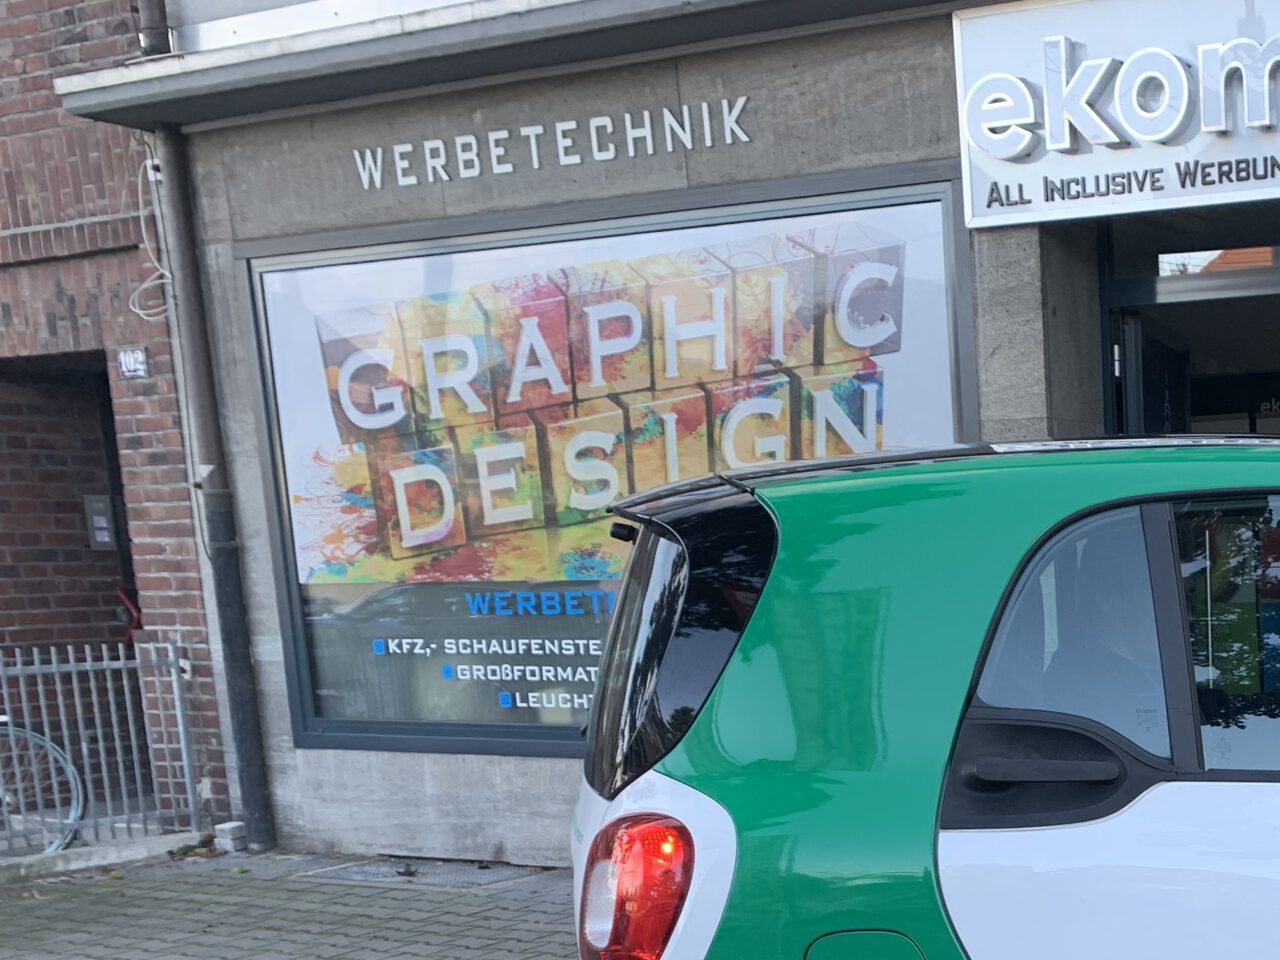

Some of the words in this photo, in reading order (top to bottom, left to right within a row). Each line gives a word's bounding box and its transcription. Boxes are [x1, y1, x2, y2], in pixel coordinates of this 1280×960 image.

[353, 95, 751, 190] WERBETECHNIK
[119, 349, 145, 372] 102
[337, 261, 899, 431] GRAPHIC
[390, 381, 880, 548] DESIGN
[444, 639, 602, 655] SCHAUFENSTE
